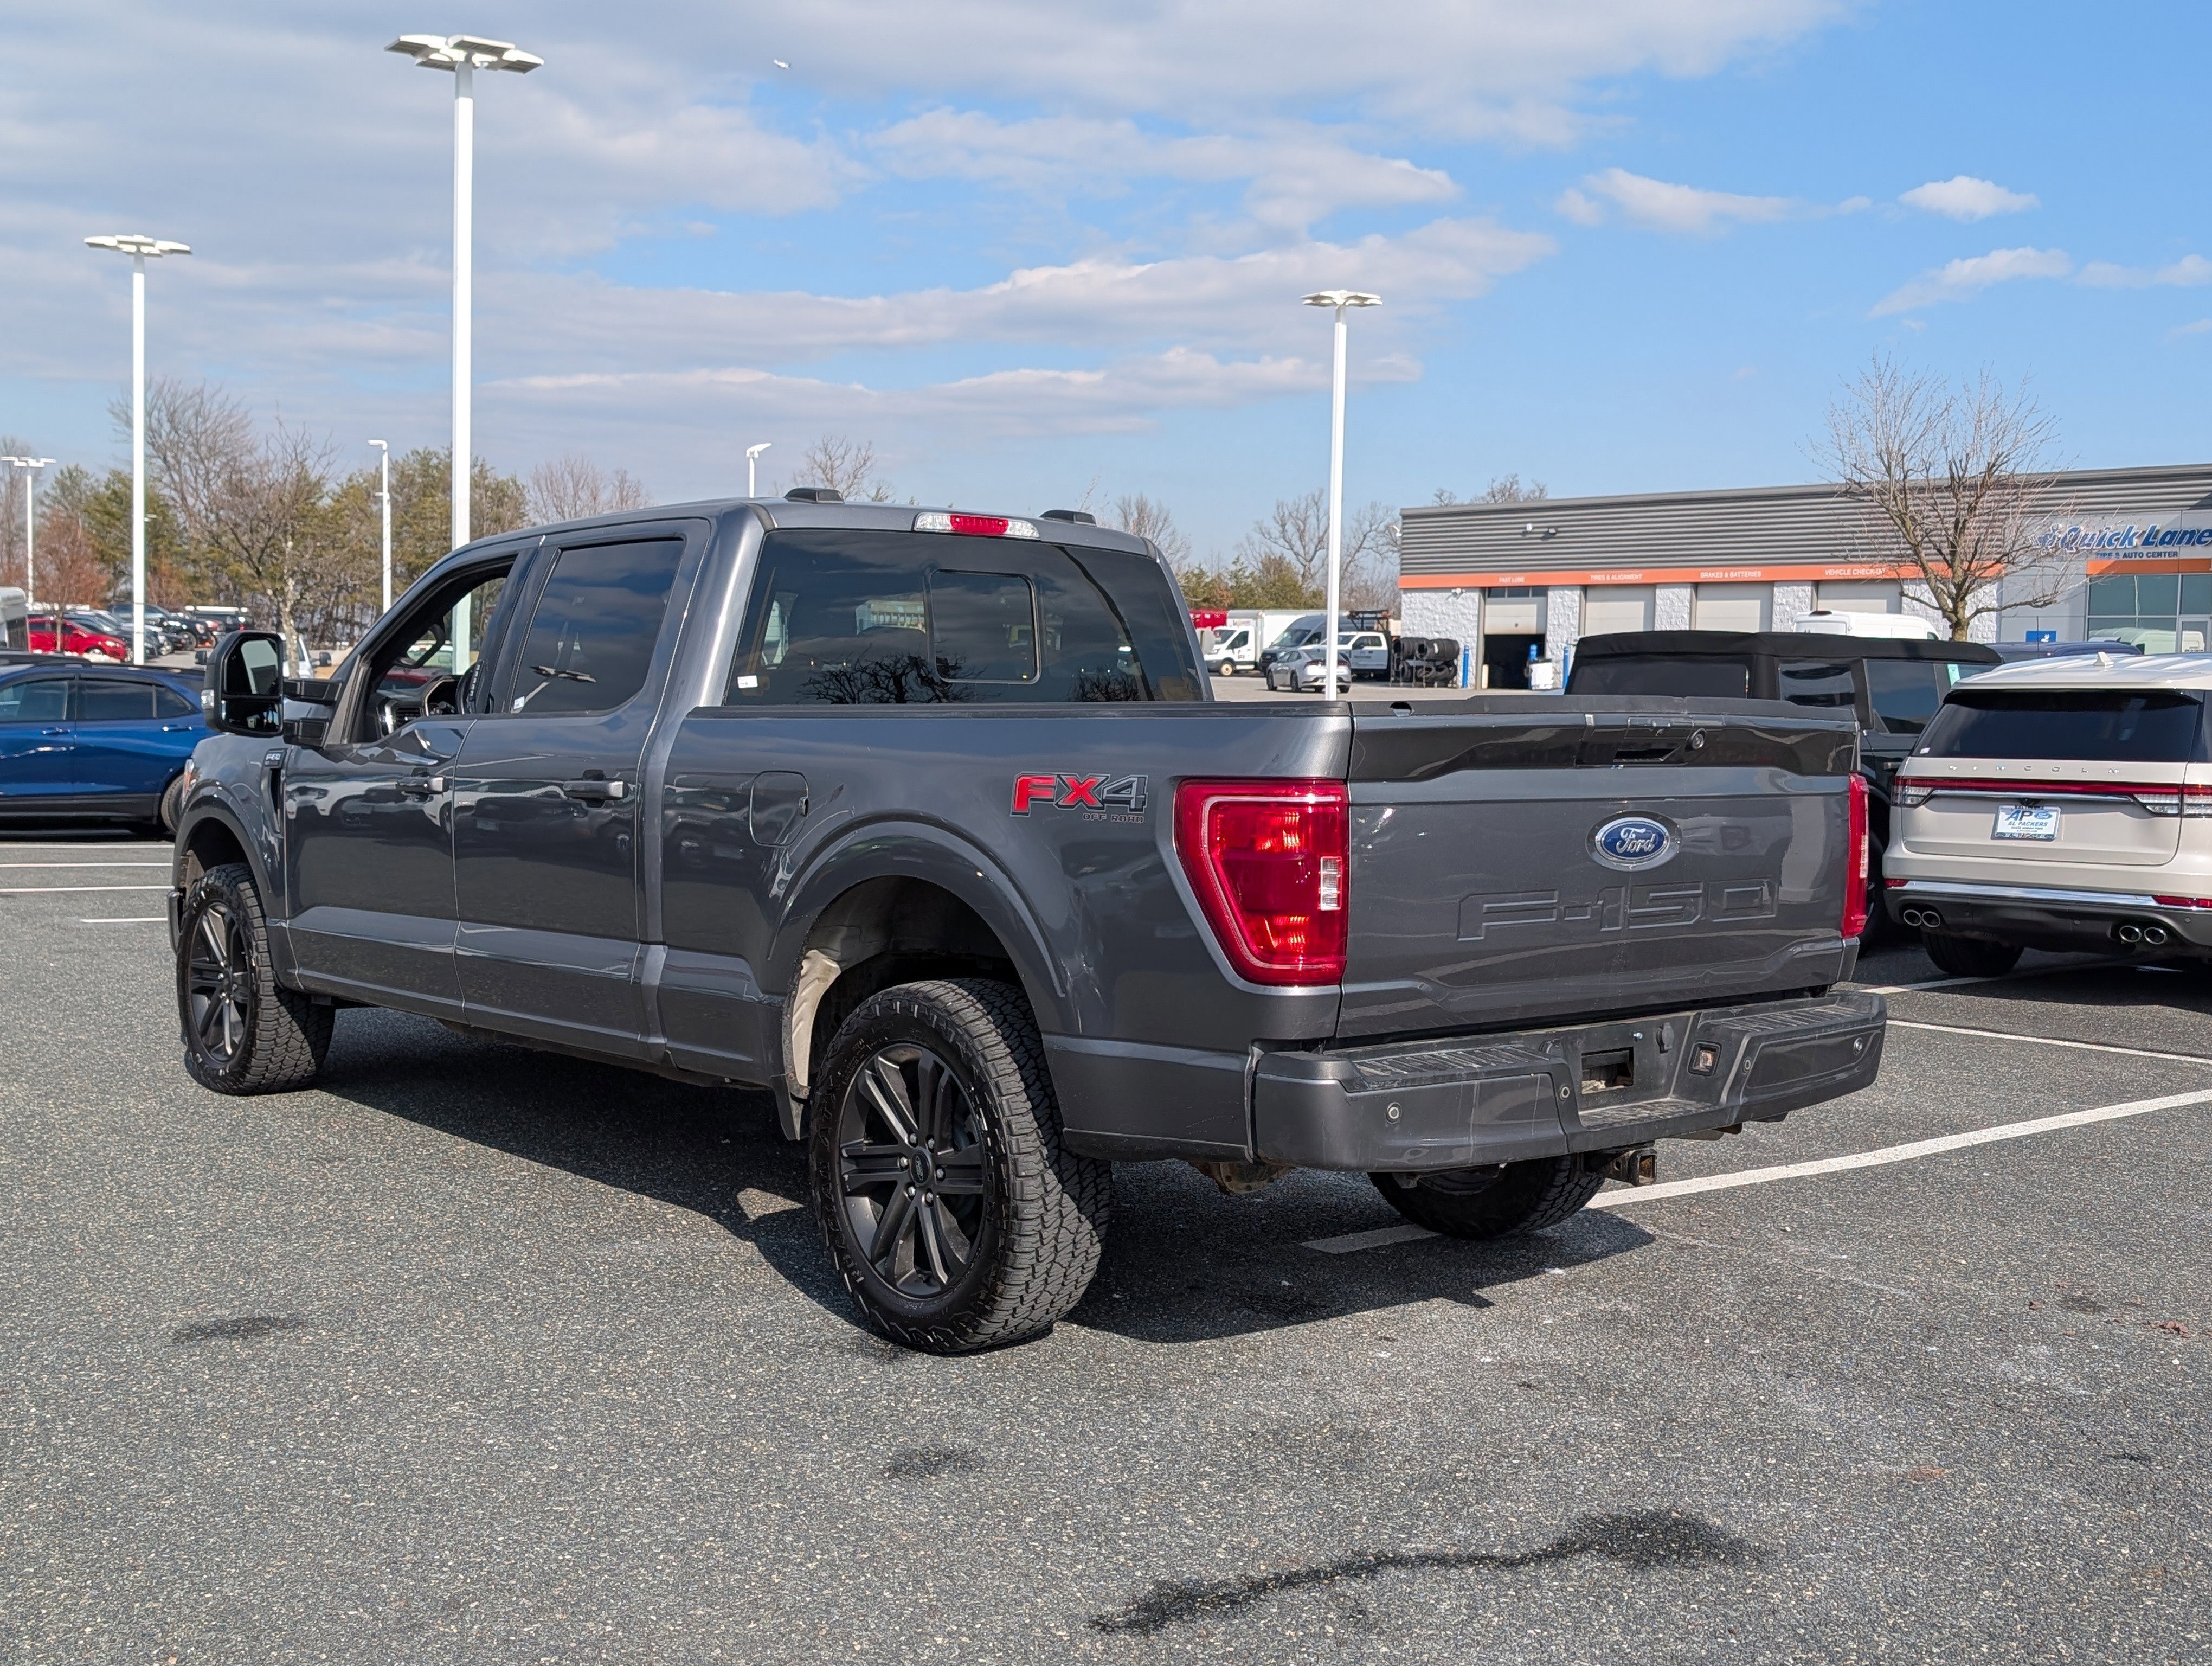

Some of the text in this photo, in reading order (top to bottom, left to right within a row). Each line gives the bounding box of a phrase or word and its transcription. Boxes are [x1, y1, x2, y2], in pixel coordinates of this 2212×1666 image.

[2060, 524, 2212, 552] Quick Lane
[1010, 771, 1149, 817] FX4
[1083, 813, 1145, 824] OFF ROAD
[2005, 810, 2033, 821] AP
[1616, 826, 1656, 854] Ford
[1457, 876, 1779, 941] F-150
